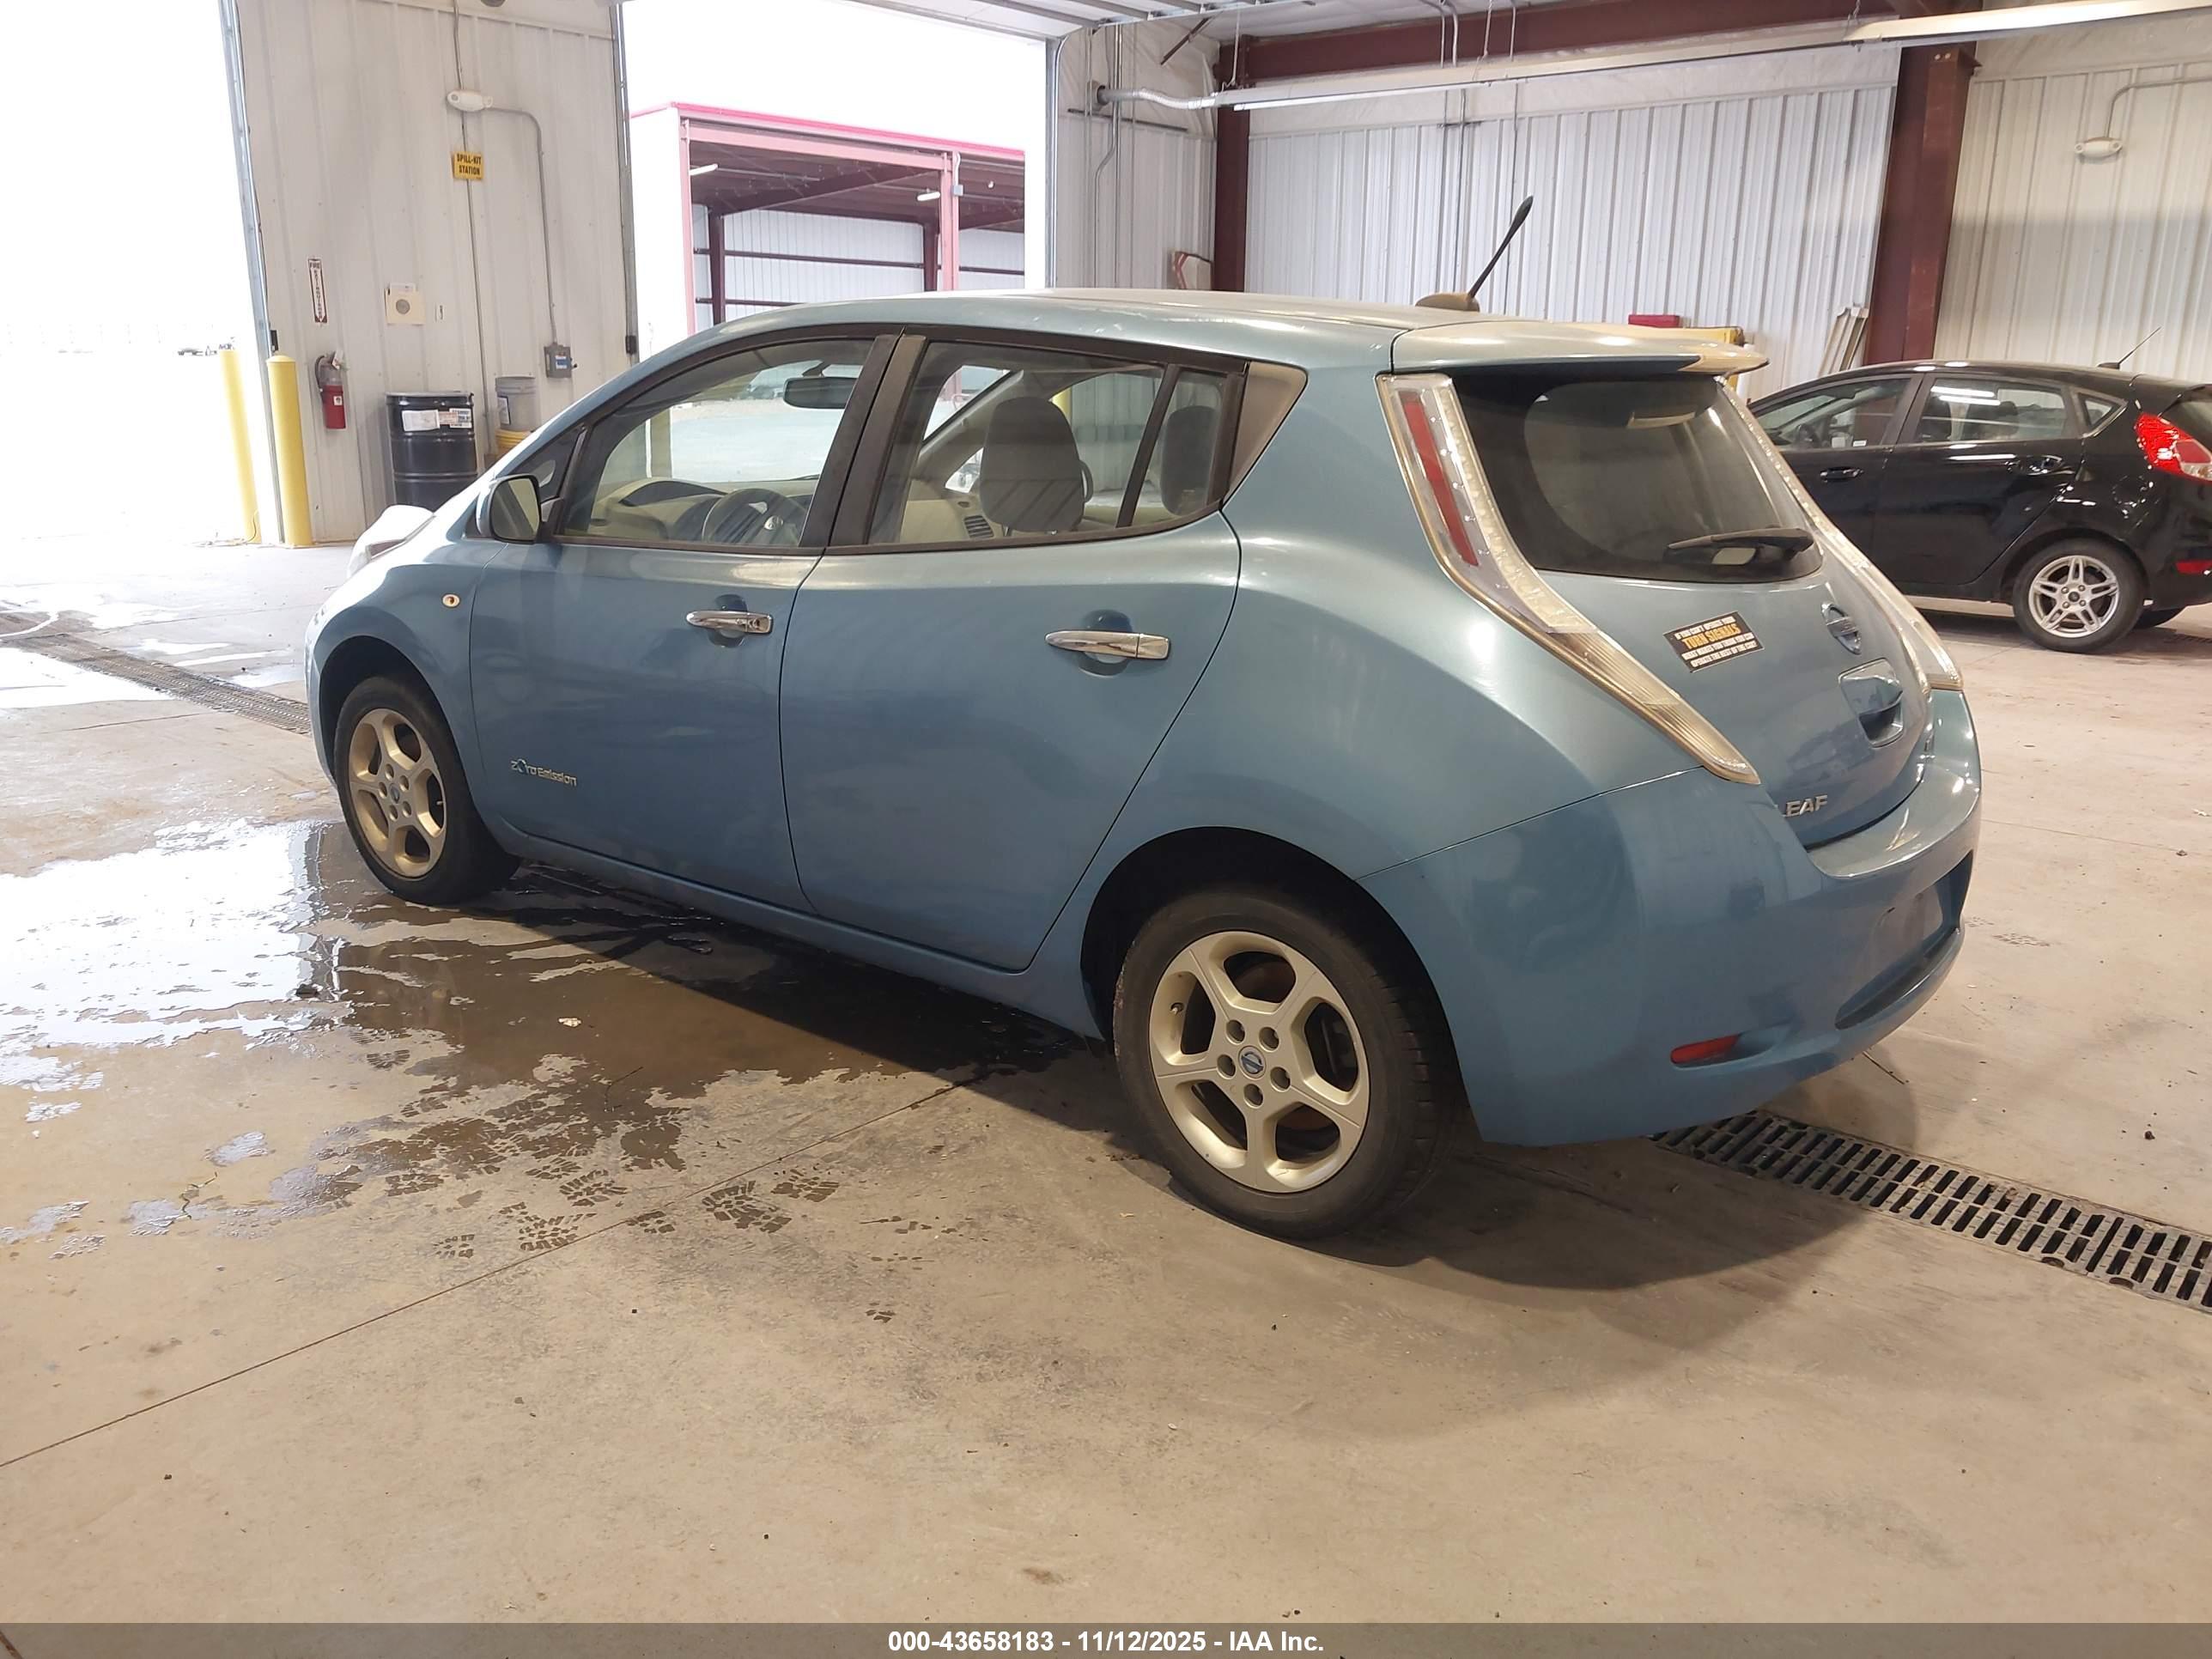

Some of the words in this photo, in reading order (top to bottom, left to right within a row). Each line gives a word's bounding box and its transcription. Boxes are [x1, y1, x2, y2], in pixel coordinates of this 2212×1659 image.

[456, 153, 482, 165] SPILL-KIT
[459, 164, 481, 176] STATION
[1781, 794, 1828, 817] EAF
